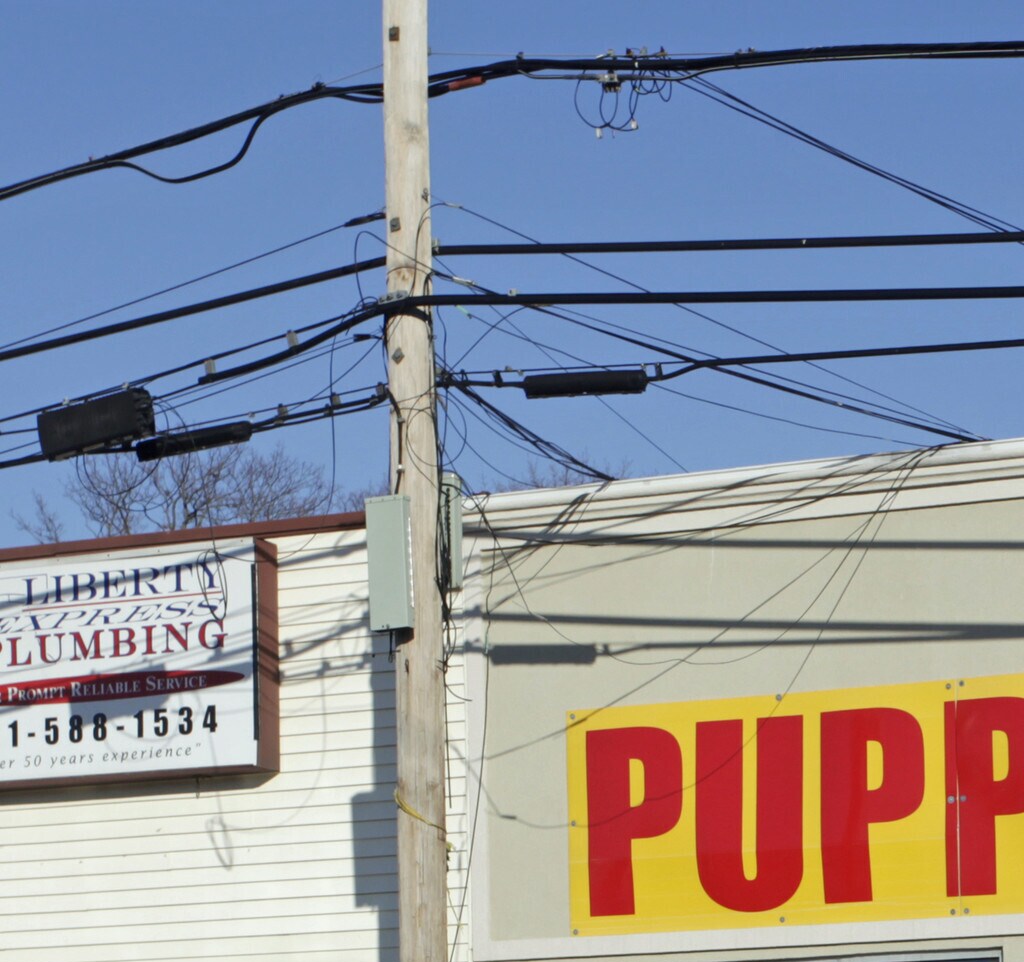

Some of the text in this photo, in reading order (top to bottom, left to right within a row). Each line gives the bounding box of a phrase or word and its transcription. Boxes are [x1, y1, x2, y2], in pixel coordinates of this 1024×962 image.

[25, 560, 223, 606] LIBERTY
[0, 620, 228, 667] LUMBING
[7, 675, 207, 702] PROMPT RELIABLE SERVICE
[24, 755, 42, 768] 50
[50, 752, 94, 768] years
